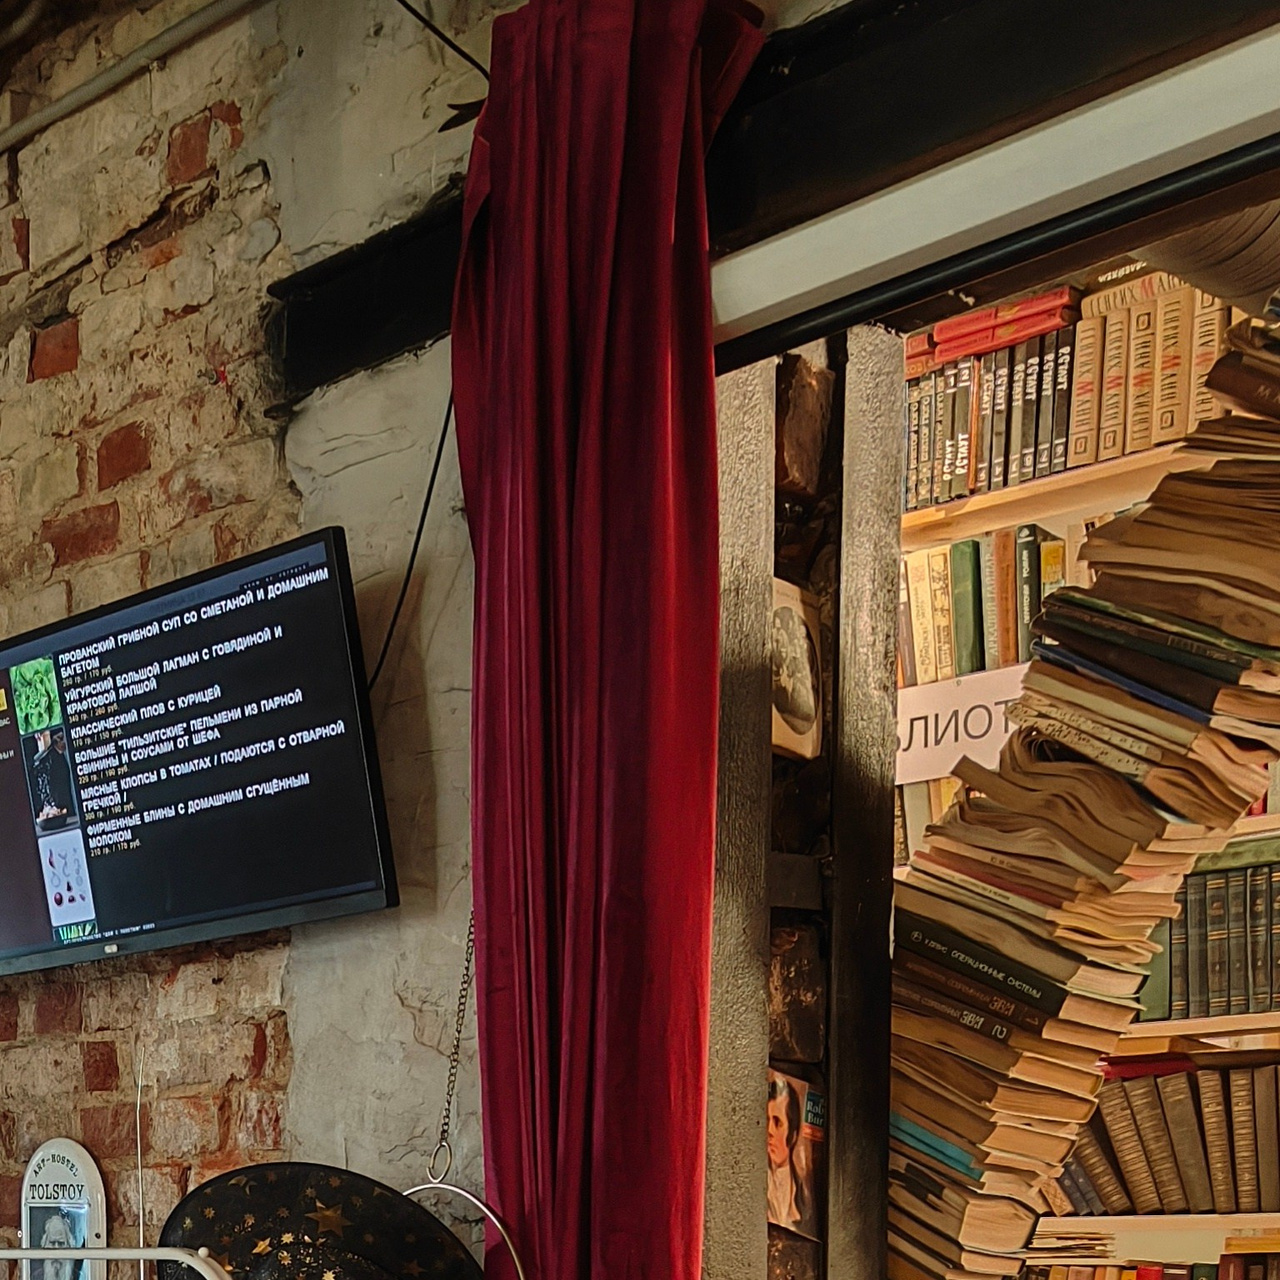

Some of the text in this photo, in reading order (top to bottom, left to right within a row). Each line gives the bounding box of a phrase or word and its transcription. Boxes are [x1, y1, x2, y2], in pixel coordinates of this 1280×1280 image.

[1160, 300, 1181, 403] ГЕНРИХ МАНН
[1194, 317, 1216, 367] МАНН
[1057, 346, 1071, 391] Р.СТАУТ
[1075, 327, 1096, 429] ГЕНРИХ МАНН
[1105, 320, 1124, 425] ГЕНРИХ МАНН
[1131, 339, 1153, 442] ГЕНРИХ МАНН
[59, 636, 116, 666] ПРОВАНСКИЙ
[118, 622, 160, 647] ГРИБНОЙ
[161, 616, 181, 632] СУП
[183, 611, 198, 624] СО
[200, 590, 254, 619] СМЕТАНОЙ
[257, 588, 265, 601] И
[267, 567, 329, 600] ДОМАШНИМ
[60, 656, 100, 678] БАГЕТОМ
[64, 625, 283, 702] УЙГУРСКИЙ БОЛЬШОЙ ЛАГМАН С ГОВЯДИНОЙ И
[66, 678, 158, 715] КРАФТОВОЙ ЛАПШОЙ
[70, 685, 221, 739] КЛАССИЧЕСКИЙ ПЛОВ С КУРИЦЕЙ
[75, 688, 303, 763] БОЛЬШИЕ "ТИЛЬЗИТСКИЕ" ПЕЛЬМЕНИ ИЗ ПАРНОЙ
[897, 697, 1020, 752] ЛИОТ
[77, 728, 221, 776] СВИНИНЫ И СОУСАМИ ОТ ШЕФА
[81, 782, 119, 800] МЯСНЫЕ
[120, 771, 158, 790] КЛОПСЫ
[160, 768, 167, 780] В
[169, 756, 211, 777] ТОМАТАХ
[220, 740, 275, 764] ПОДАЮТСЯ
[278, 737, 286, 749] С
[289, 720, 346, 746] ОТВАРНОЙ
[82, 792, 121, 812] ГРЕЧКОЙ
[86, 772, 310, 836] ФИРМЕННЫЕ БЛИНЫ С ДОМАШНИМ СГУЩЁННЫМ
[88, 829, 132, 849] МОЛОКОМ
[989, 996, 1016, 1017] ЭВМ
[1007, 976, 1042, 999] СИСТЕМЫ
[959, 1010, 1007, 1039] ЭВМ 2
[33, 1154, 79, 1178] ART-HOSTEL
[29, 1183, 85, 1200] TOLSTOY
